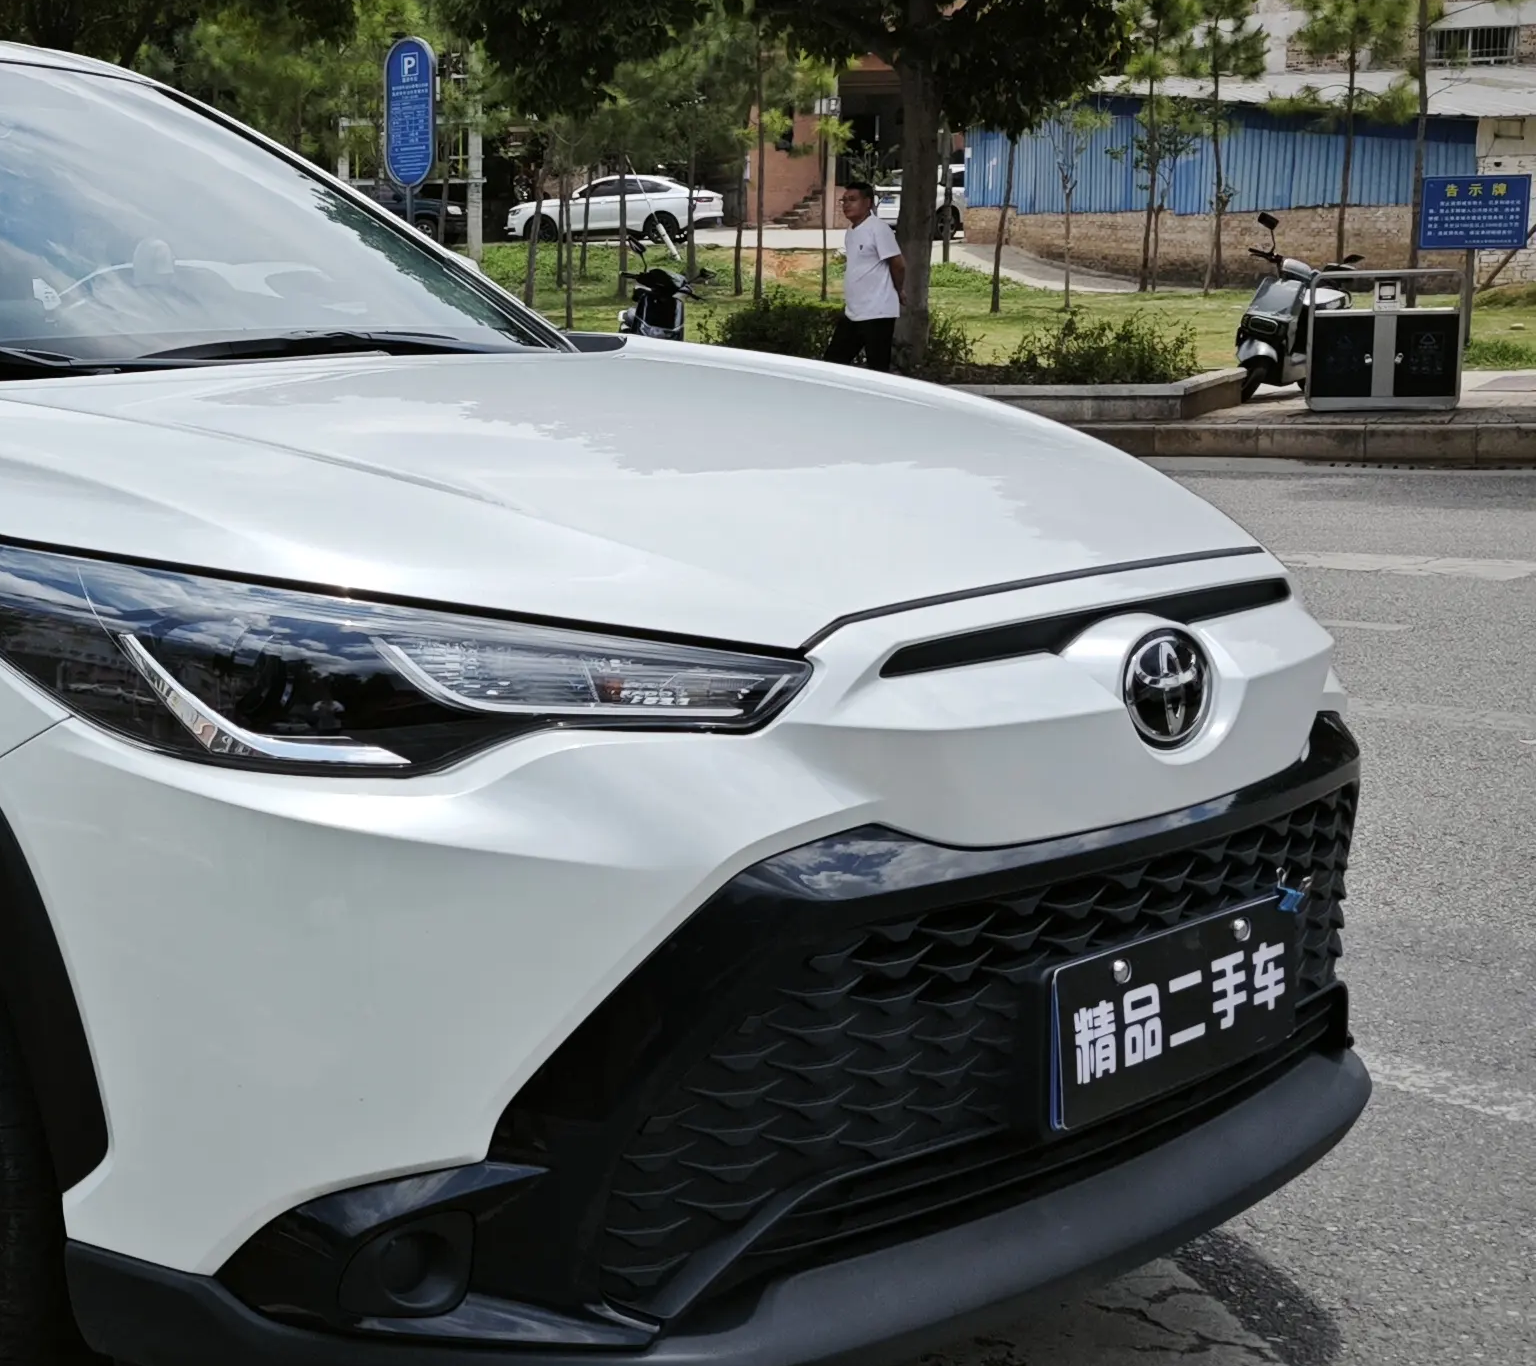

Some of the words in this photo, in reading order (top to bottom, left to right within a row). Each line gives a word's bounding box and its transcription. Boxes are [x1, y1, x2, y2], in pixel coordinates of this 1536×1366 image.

[404, 56, 416, 75] P
[1444, 183, 1508, 197] 告示牌
[1073, 942, 1286, 1084] 精品二手车
